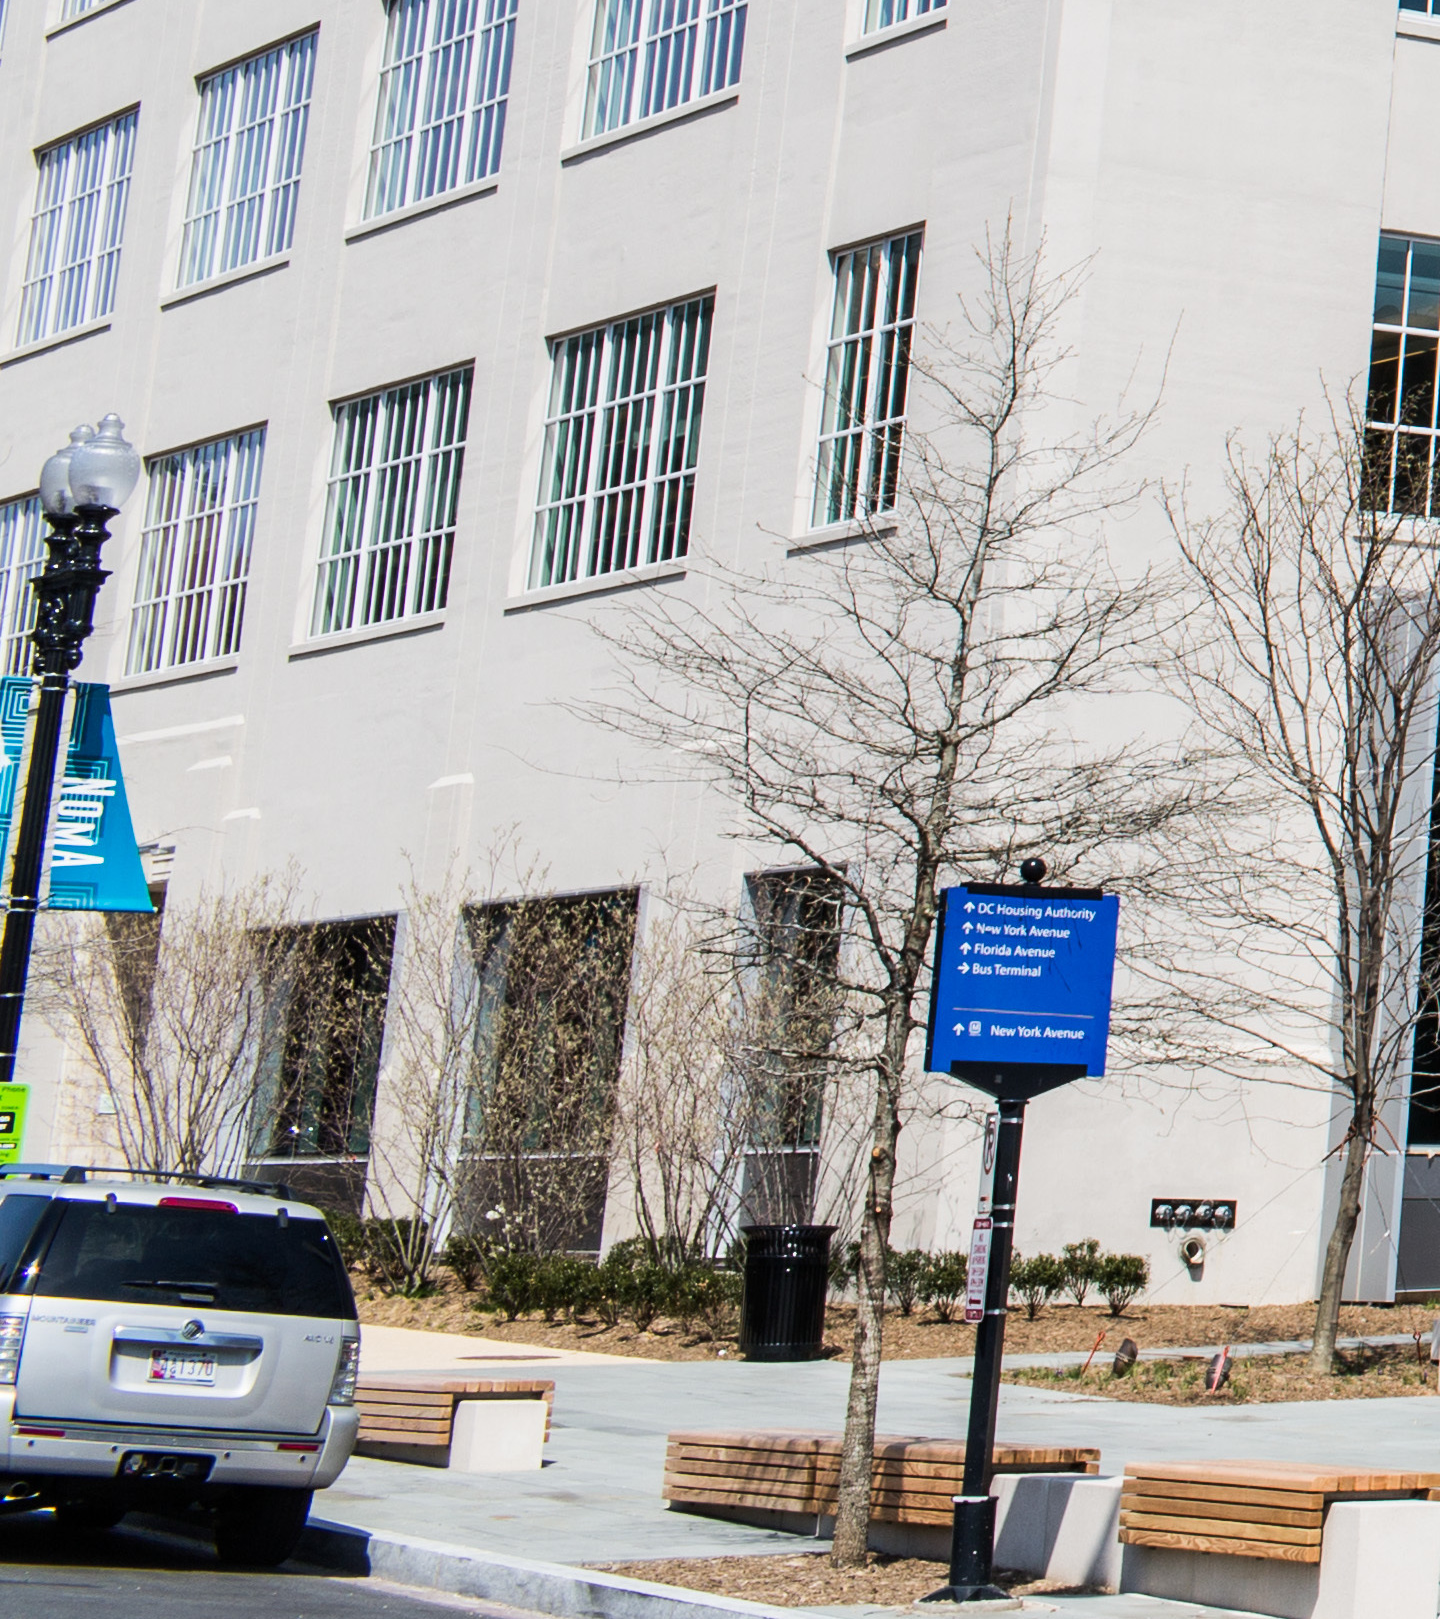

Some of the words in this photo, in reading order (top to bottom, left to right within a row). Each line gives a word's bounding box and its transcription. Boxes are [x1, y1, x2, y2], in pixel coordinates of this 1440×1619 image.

[51, 776, 117, 868] NOMA
[977, 902, 995, 915] DC
[996, 904, 1042, 920] Housing
[1044, 905, 1096, 922] Authority
[976, 922, 1001, 935] New
[1003, 924, 1027, 937] York
[1028, 925, 1071, 939] Avenue
[973, 943, 1012, 957] Florida
[1013, 945, 1056, 958] Avenue
[972, 963, 993, 975] Bus
[994, 964, 1042, 977] Terminal
[990, 1025, 1016, 1037] New
[1017, 1025, 1042, 1038] York
[1043, 1027, 1085, 1040] Avenue
